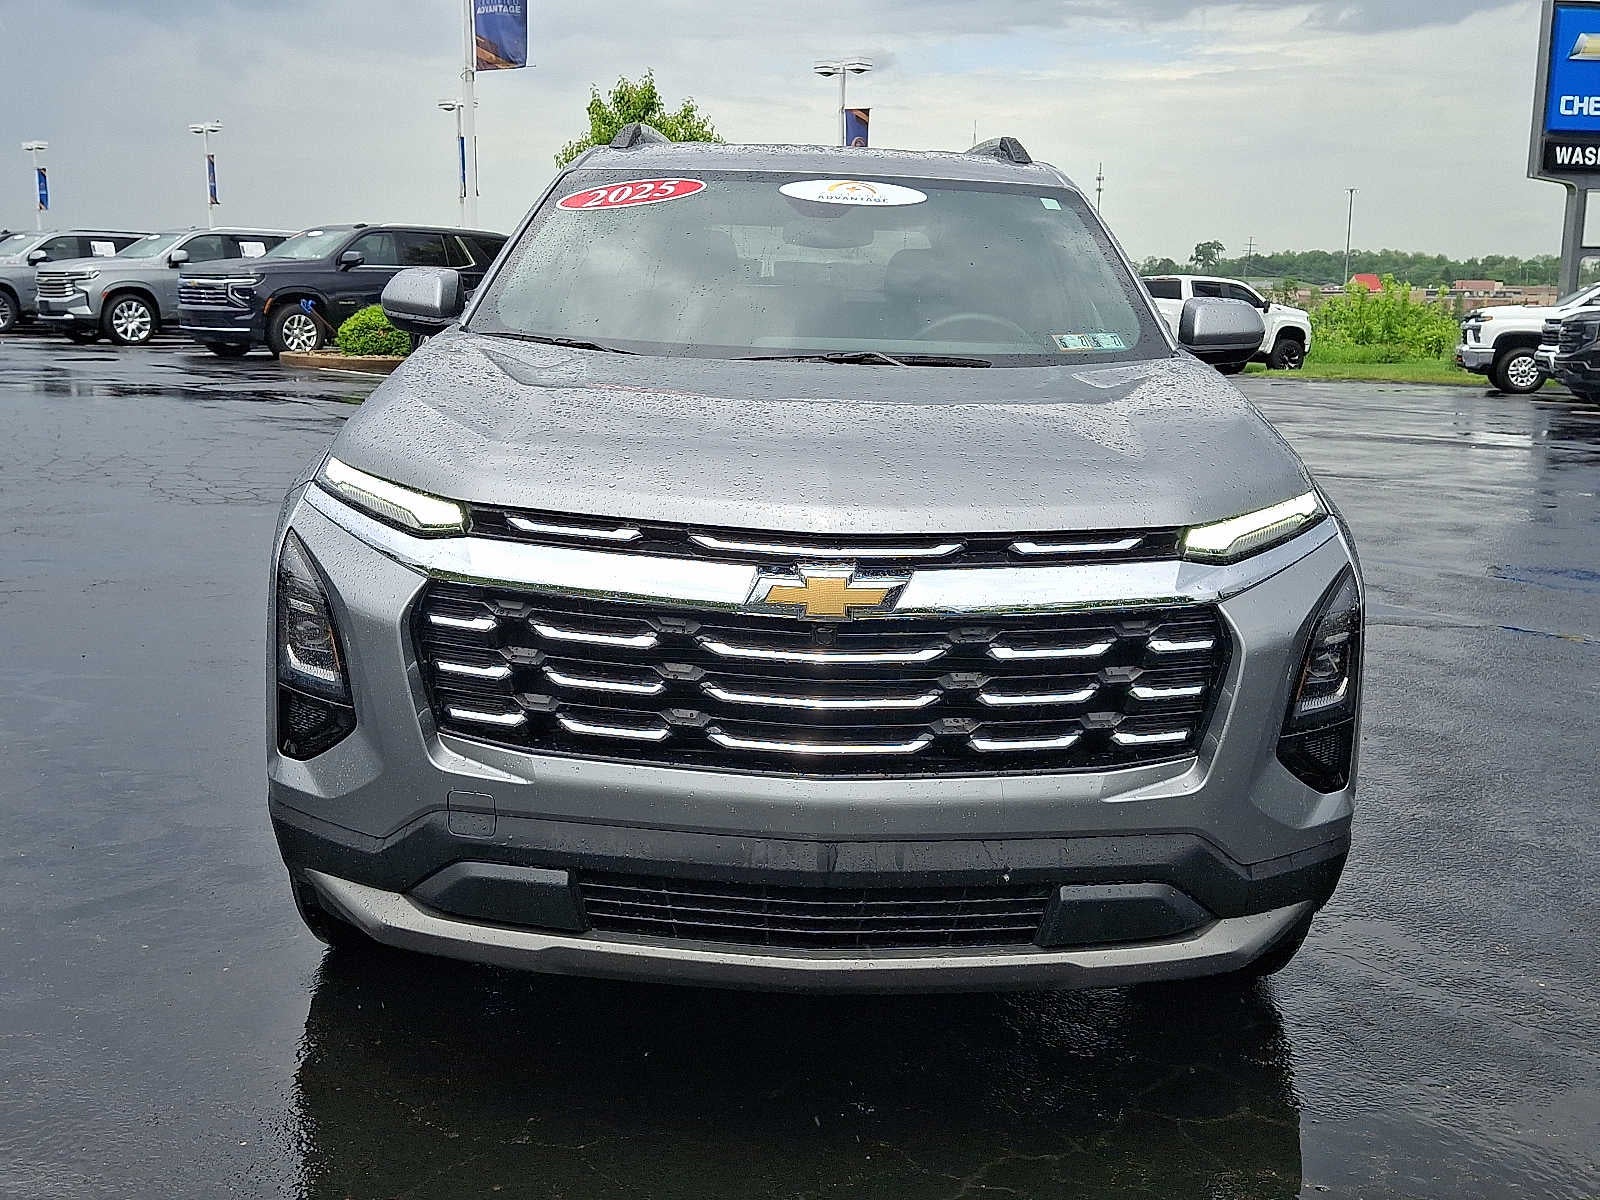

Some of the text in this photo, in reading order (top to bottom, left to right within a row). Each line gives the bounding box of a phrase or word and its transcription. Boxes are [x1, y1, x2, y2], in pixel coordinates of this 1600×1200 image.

[476, 5, 521, 14] ADVANTAGE
[1555, 145, 1600, 166] WAS
[582, 180, 680, 208] 2025
[817, 194, 889, 204] ADVANTAGE
